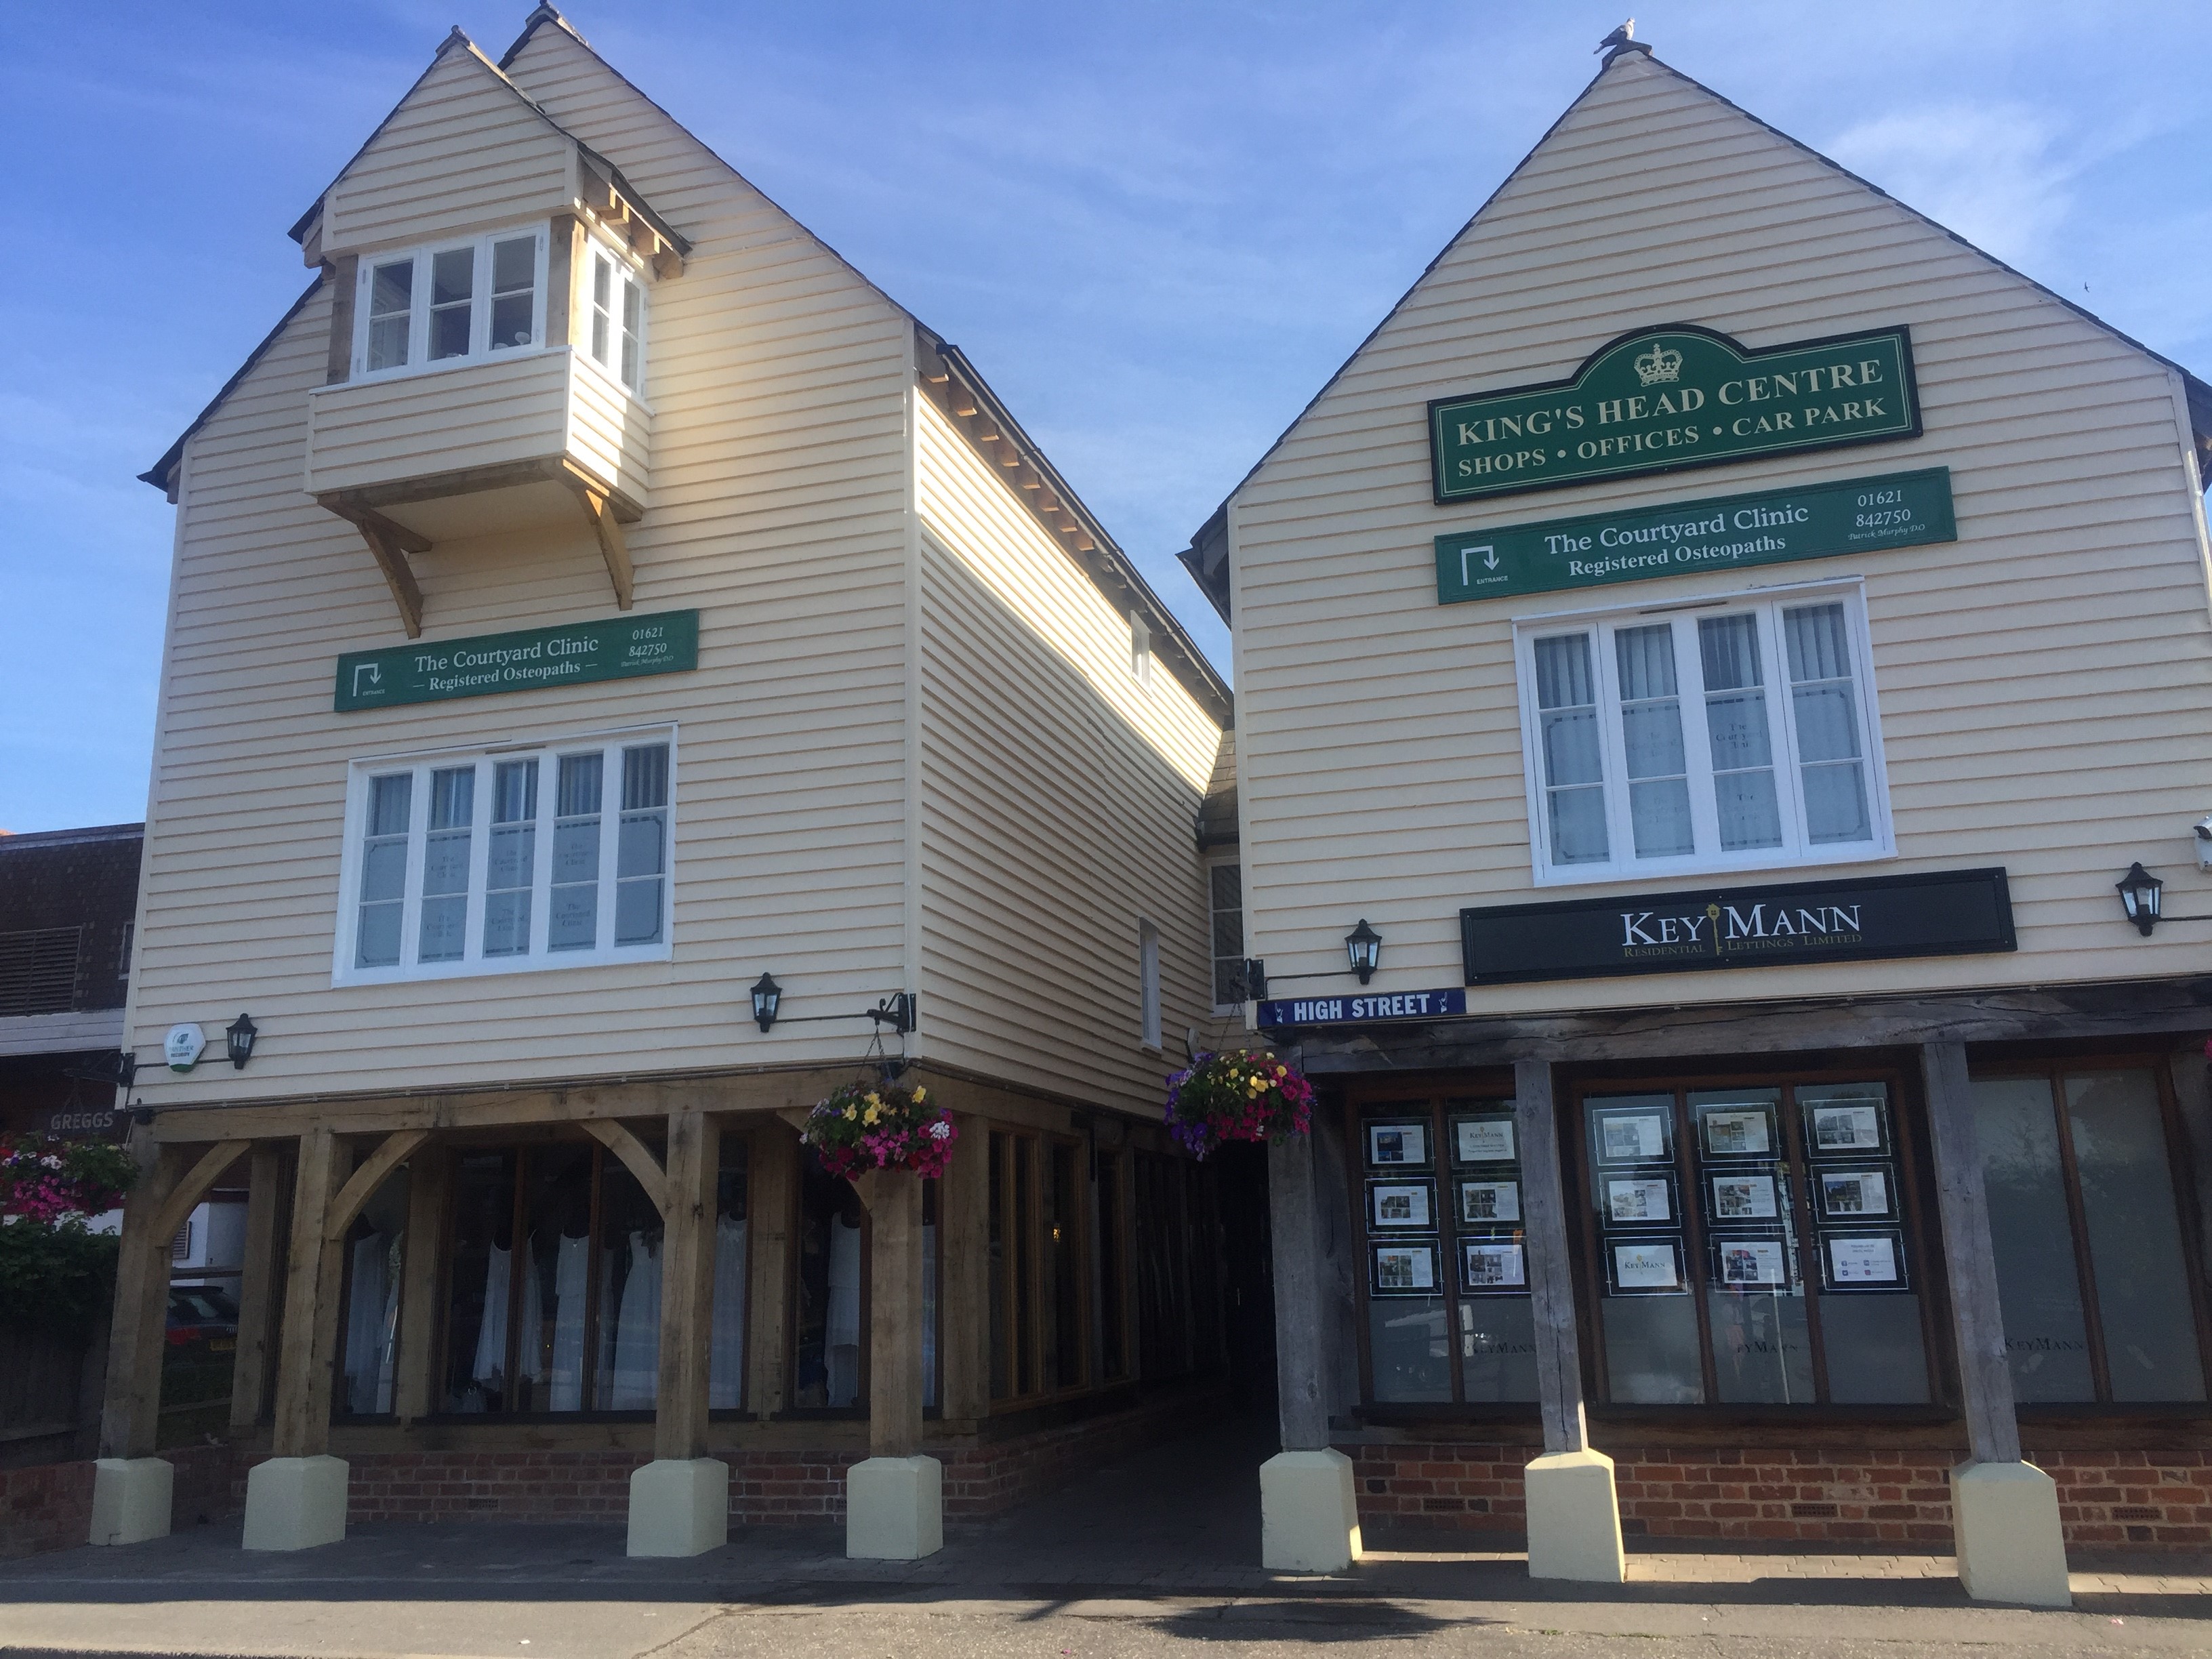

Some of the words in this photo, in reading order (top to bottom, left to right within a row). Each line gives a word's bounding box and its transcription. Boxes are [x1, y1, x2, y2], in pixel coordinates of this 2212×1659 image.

[1457, 405, 1584, 447] KING'S
[1597, 388, 1704, 425] HEAD
[1718, 359, 1883, 406] CENTRE
[1458, 448, 1546, 477] SHOPS
[1577, 426, 1700, 460] OFFICES
[1732, 412, 1795, 436] CAR
[1805, 397, 1887, 427] PARK
[1858, 490, 1902, 506] 01621
[1544, 534, 1591, 554] The
[1600, 513, 1725, 551] Courtyard
[1734, 504, 1809, 529] Clinic
[1856, 509, 1911, 528] 842750
[1848, 530, 1877, 540] Patrick
[1877, 526, 1908, 537] Murphy
[1568, 548, 1669, 577] Registered
[1675, 534, 1786, 562] Osteopaths
[1476, 575, 1509, 585] ENTRANCE
[632, 627, 663, 640] 01621
[415, 655, 447, 672] The
[453, 641, 541, 668] Courtyard
[547, 636, 599, 657] Clinic
[629, 642, 668, 658] 842750
[429, 670, 499, 692] Registered
[504, 661, 581, 681] Osteopaths
[1622, 944, 1706, 957] RESIDENTIAL
[1728, 938, 1794, 950] LETTINGS
[1805, 935, 1862, 945] LIMITED
[1294, 1000, 1343, 1021] HIGH
[1352, 994, 1430, 1018] STREET
[51, 1112, 114, 1130] GREGGS
